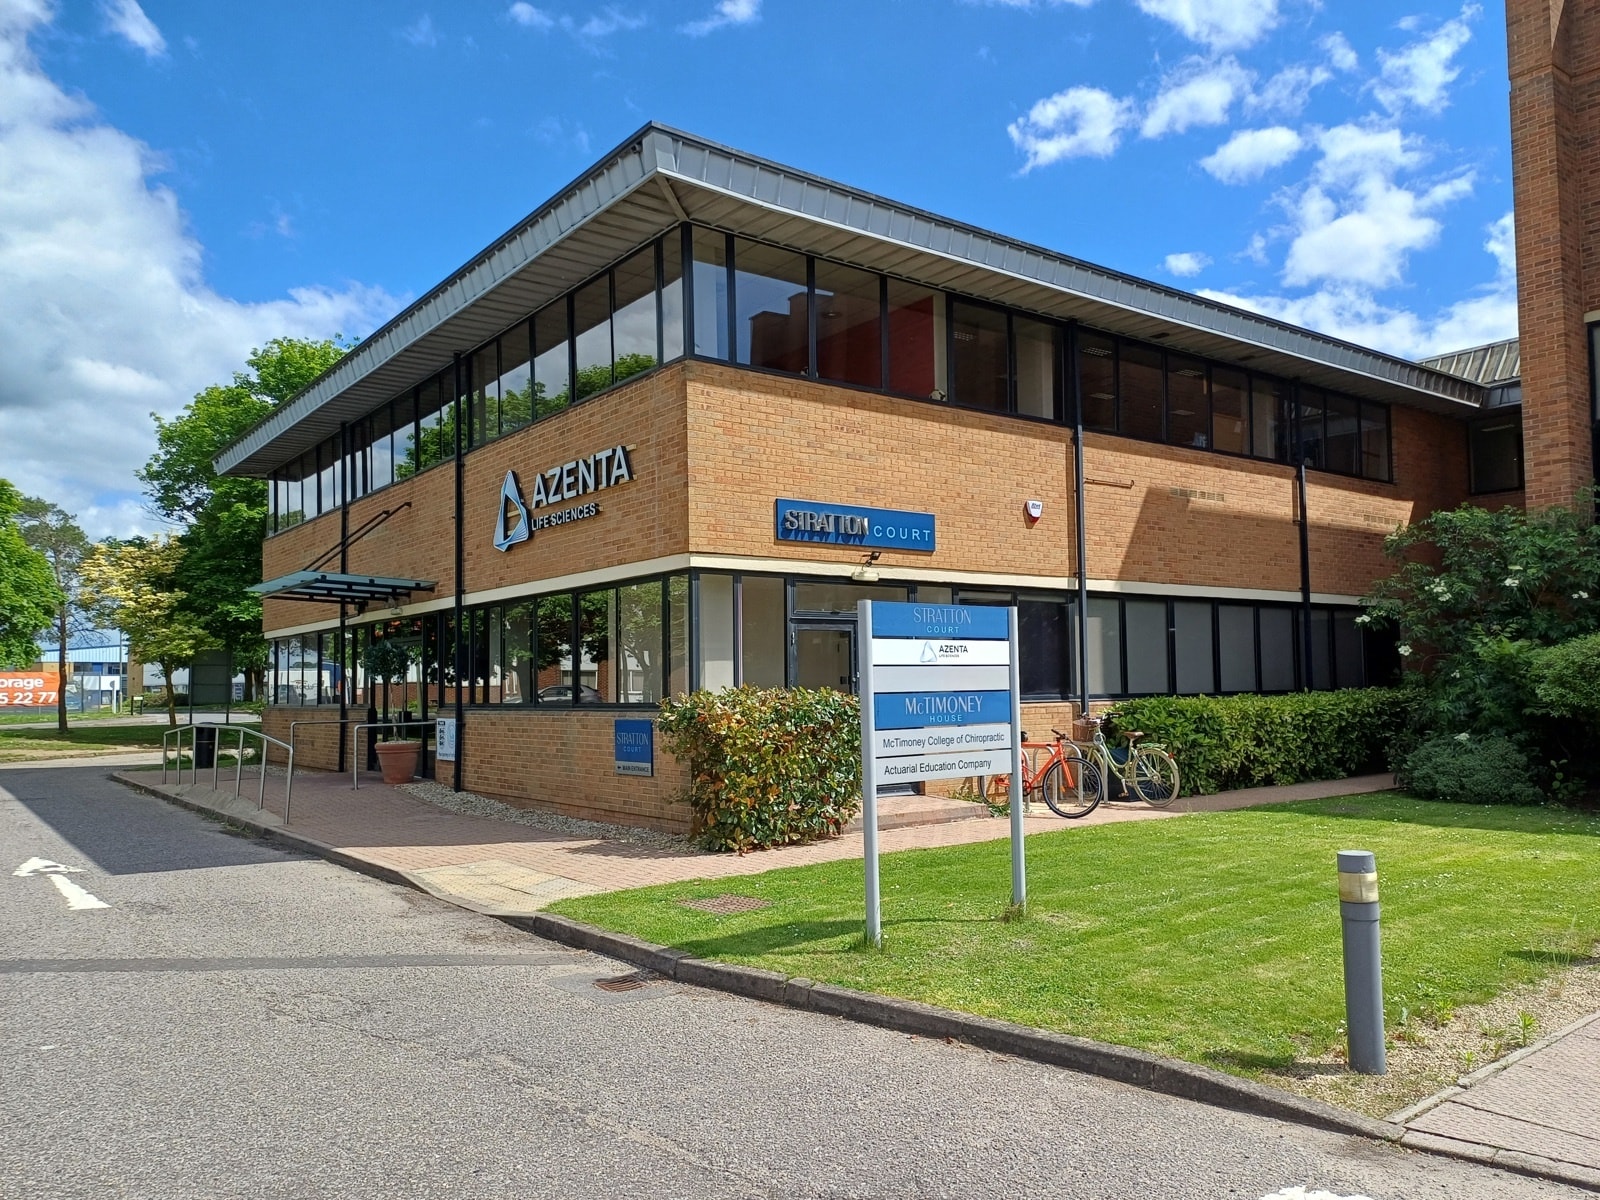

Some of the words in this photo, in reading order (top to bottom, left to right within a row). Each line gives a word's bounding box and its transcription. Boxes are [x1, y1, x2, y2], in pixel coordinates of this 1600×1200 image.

[531, 445, 631, 509] AZENTA
[531, 514, 549, 531] LIFE
[550, 502, 597, 526] SCIENCES
[784, 509, 869, 536] STRATTON
[873, 525, 931, 542] COURT
[913, 607, 972, 625] STRATTON
[926, 625, 960, 634] COURT
[939, 644, 969, 653] AZENTA
[13, 692, 33, 704] 22
[38, 691, 57, 704] 77
[905, 695, 983, 715] McTIMONEY
[929, 714, 963, 723] HOUSE
[616, 732, 649, 745] STRATTON
[882, 737, 926, 749] McTimoney
[927, 735, 955, 747] College
[956, 734, 964, 744] of
[964, 732, 1005, 745] Chiropractic
[884, 764, 918, 775] Actuarial
[919, 761, 956, 773] Education
[957, 759, 992, 771] Company
